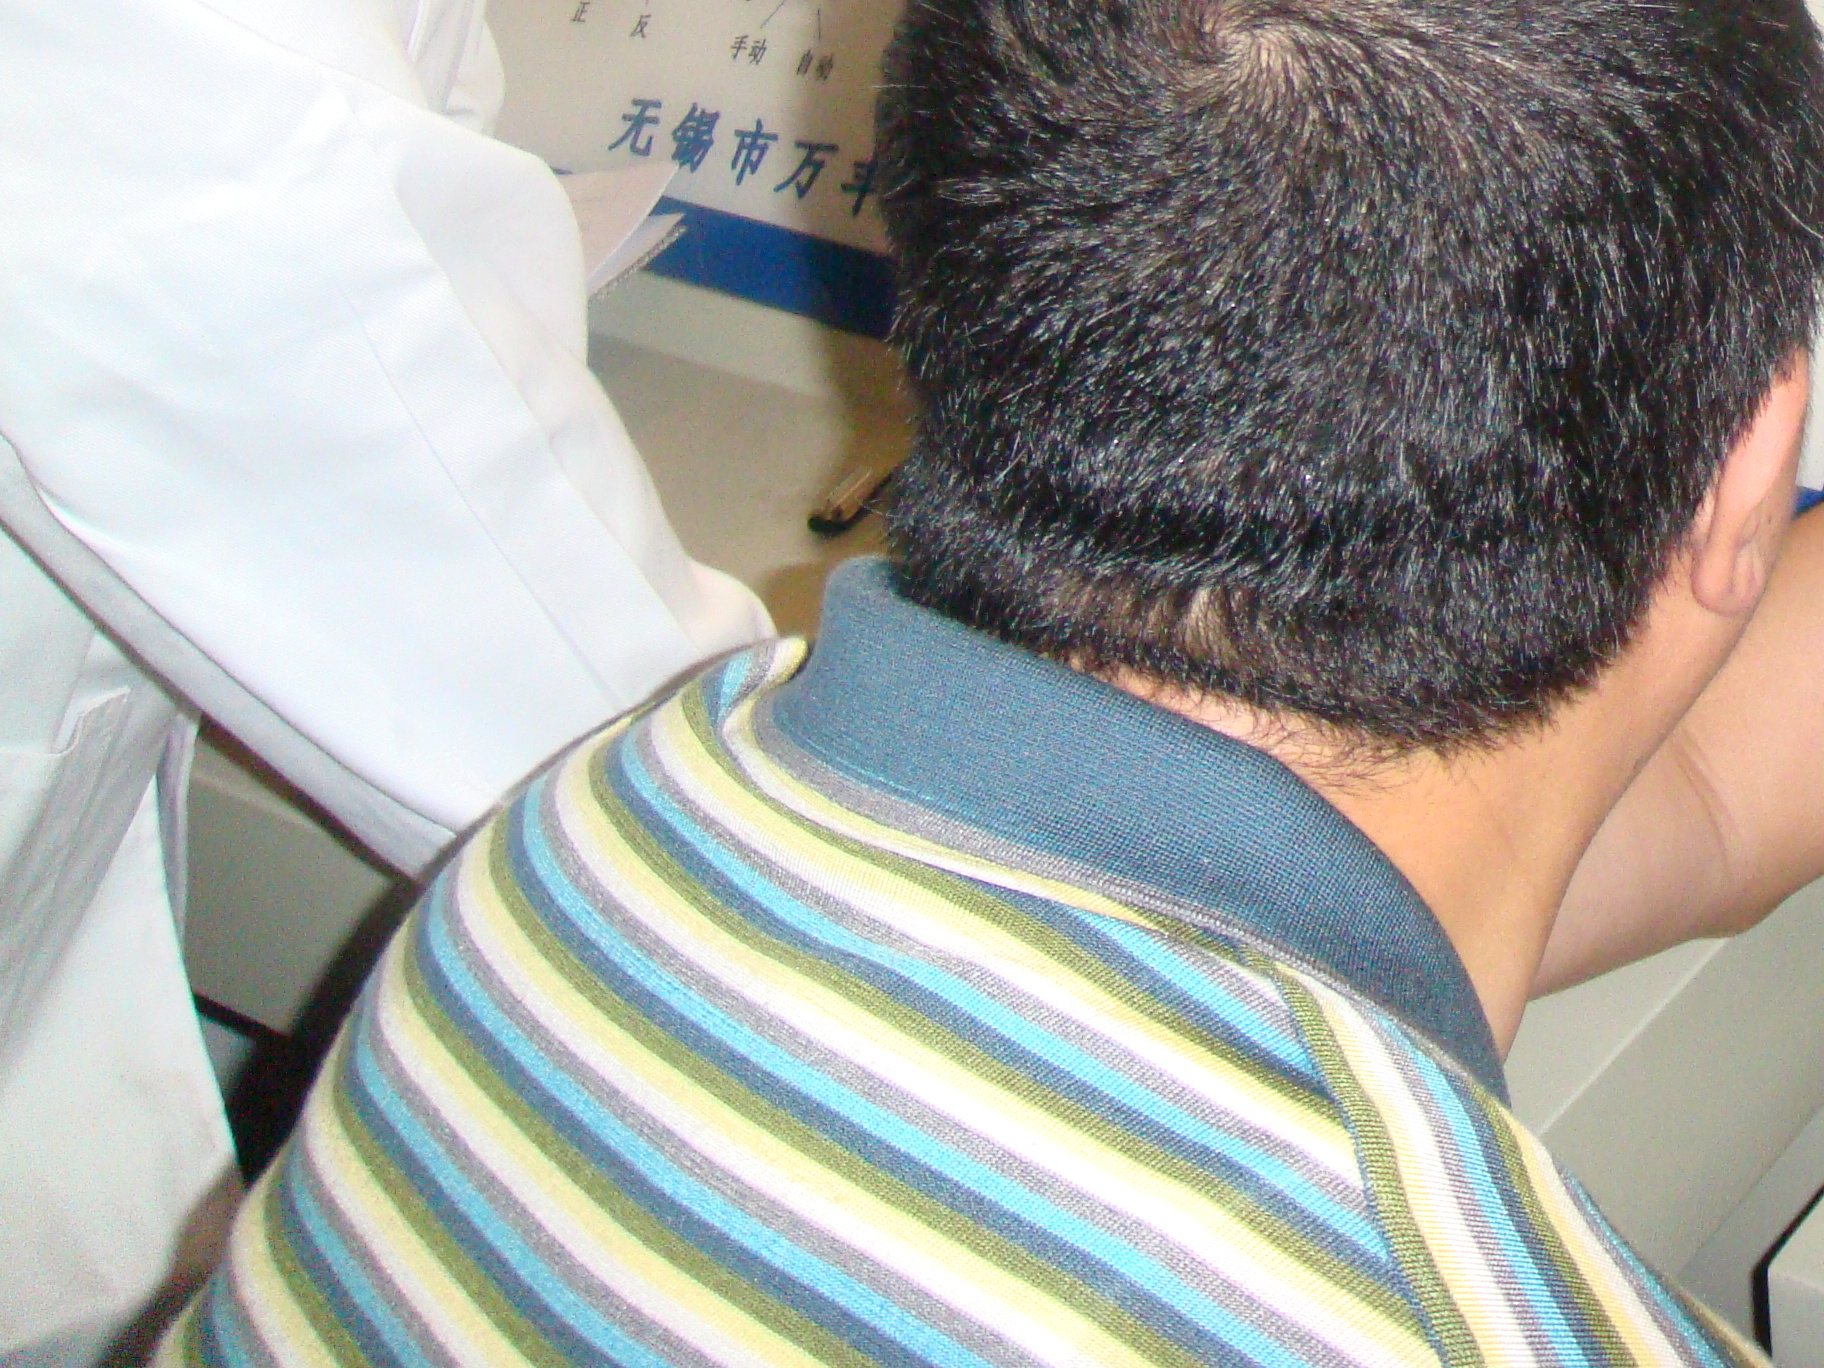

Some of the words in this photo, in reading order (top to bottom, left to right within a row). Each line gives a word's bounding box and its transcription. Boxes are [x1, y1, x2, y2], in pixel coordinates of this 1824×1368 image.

[570, 1, 591, 23] 正
[629, 13, 651, 39] 反
[730, 34, 768, 66] 手动
